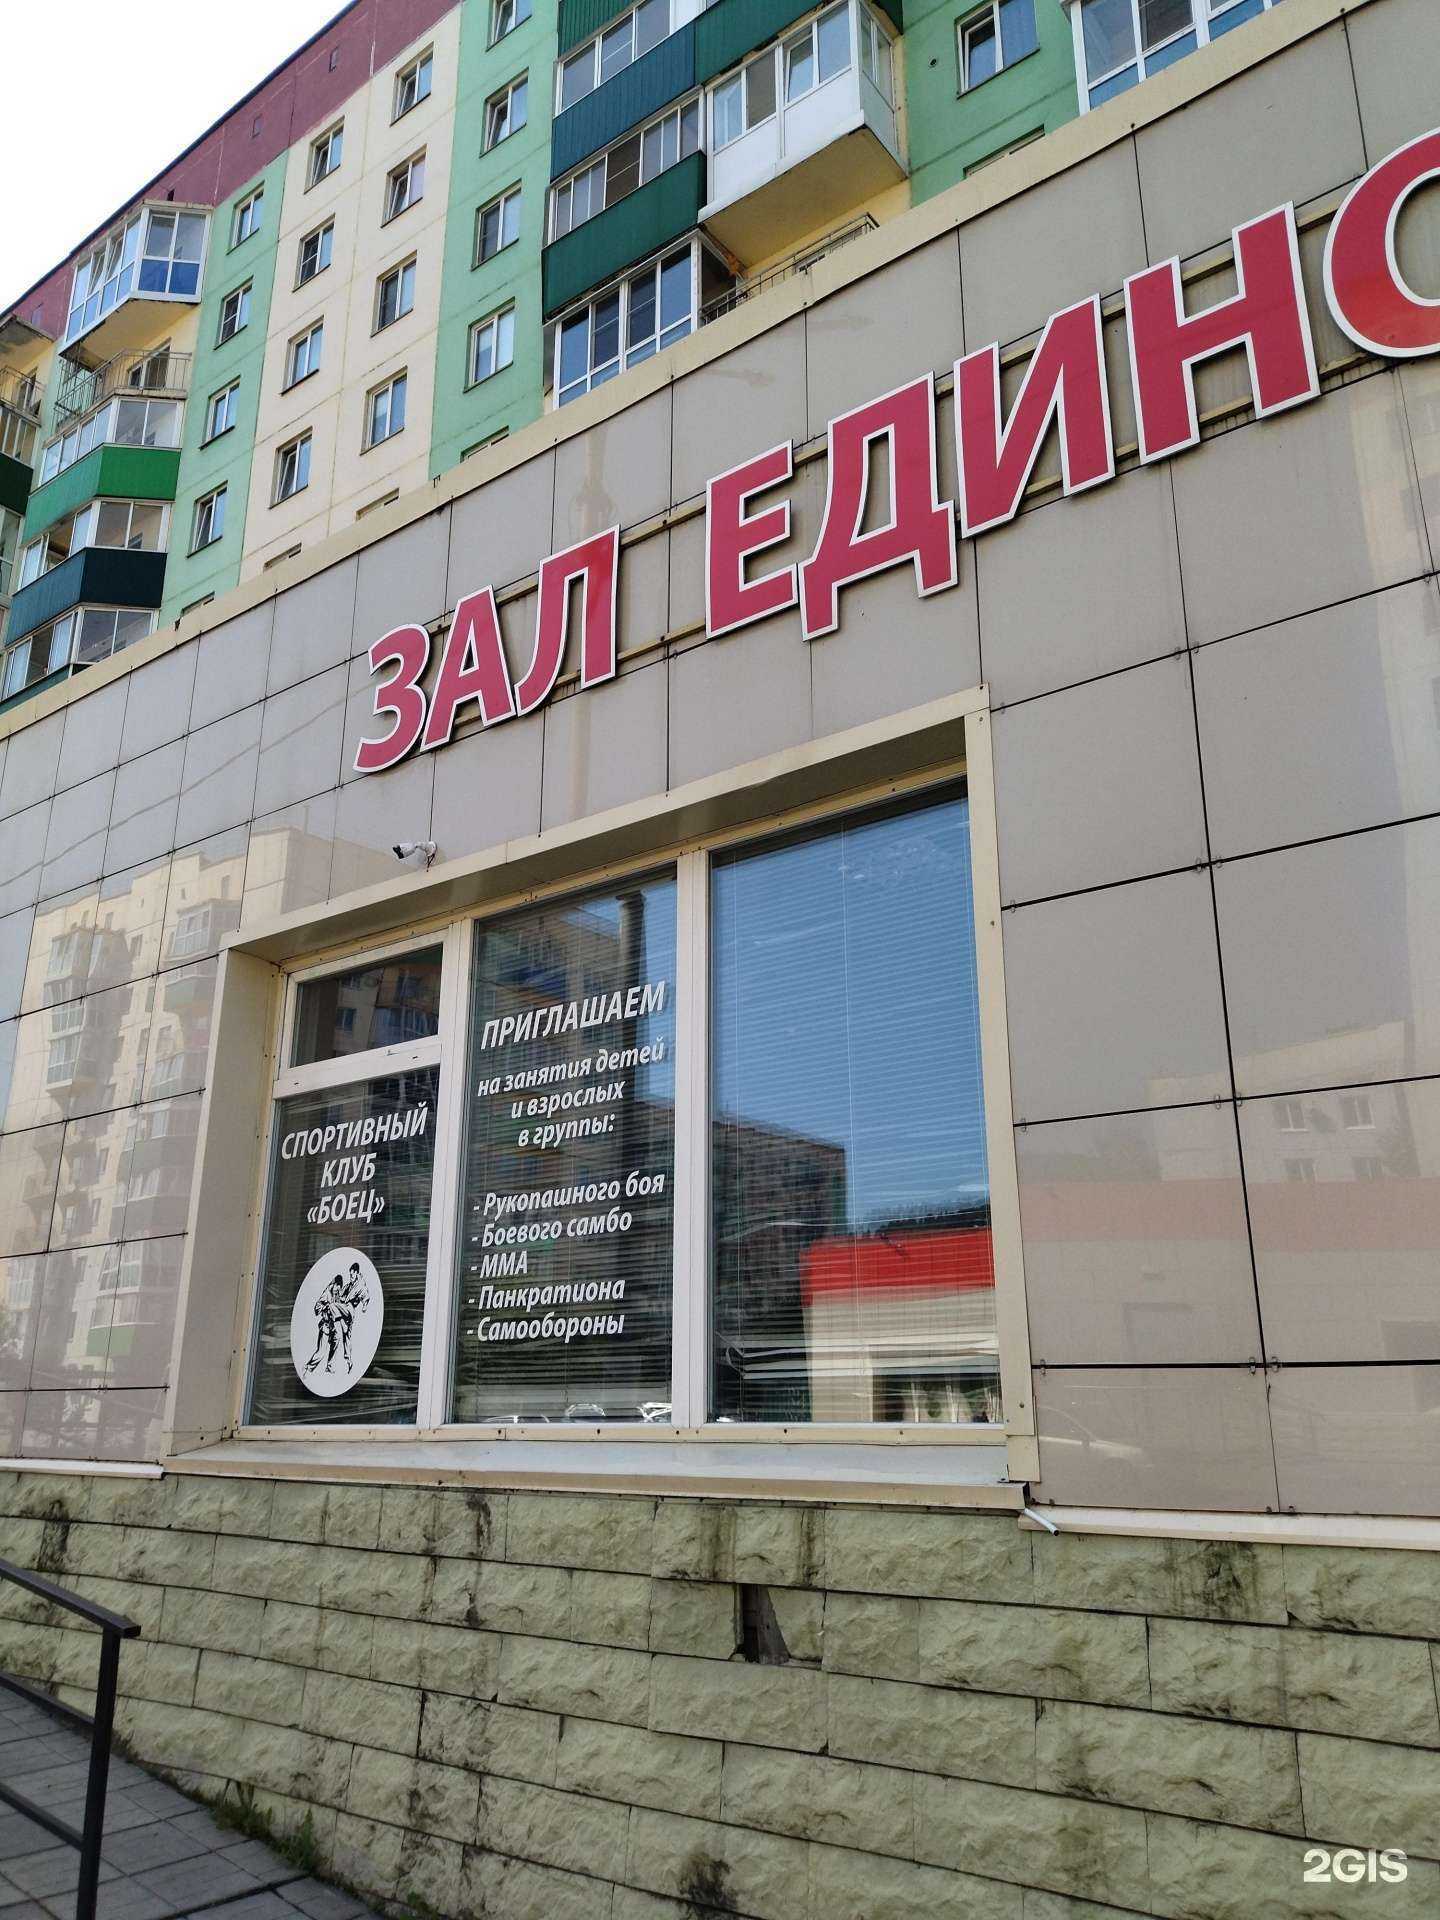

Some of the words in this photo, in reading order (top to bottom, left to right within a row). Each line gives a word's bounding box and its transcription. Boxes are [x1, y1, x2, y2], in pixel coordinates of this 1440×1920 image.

[353, 523, 621, 774] ЗАЛ
[480, 980, 665, 1050] ПРИГЛАШАЕМ
[477, 1076, 501, 1097] на
[503, 1057, 592, 1092] занятия
[595, 1036, 665, 1073] детей
[510, 1100, 523, 1119] и
[526, 1080, 626, 1119] взрослых
[281, 1101, 429, 1161] СПОРТИВНЫЙ
[518, 1128, 530, 1147] в
[532, 1113, 616, 1150] группы:
[320, 1152, 378, 1189] КЛУБ
[306, 1188, 386, 1225] «БОЕЦ»
[483, 1180, 621, 1222] Рукопашного
[624, 1171, 665, 1197] боя
[481, 1219, 562, 1248] Боевого
[566, 1207, 633, 1238] самбо
[479, 1250, 529, 1279] ММА
[478, 1278, 626, 1315] Панкратиона
[476, 1311, 625, 1343] Самообороны
